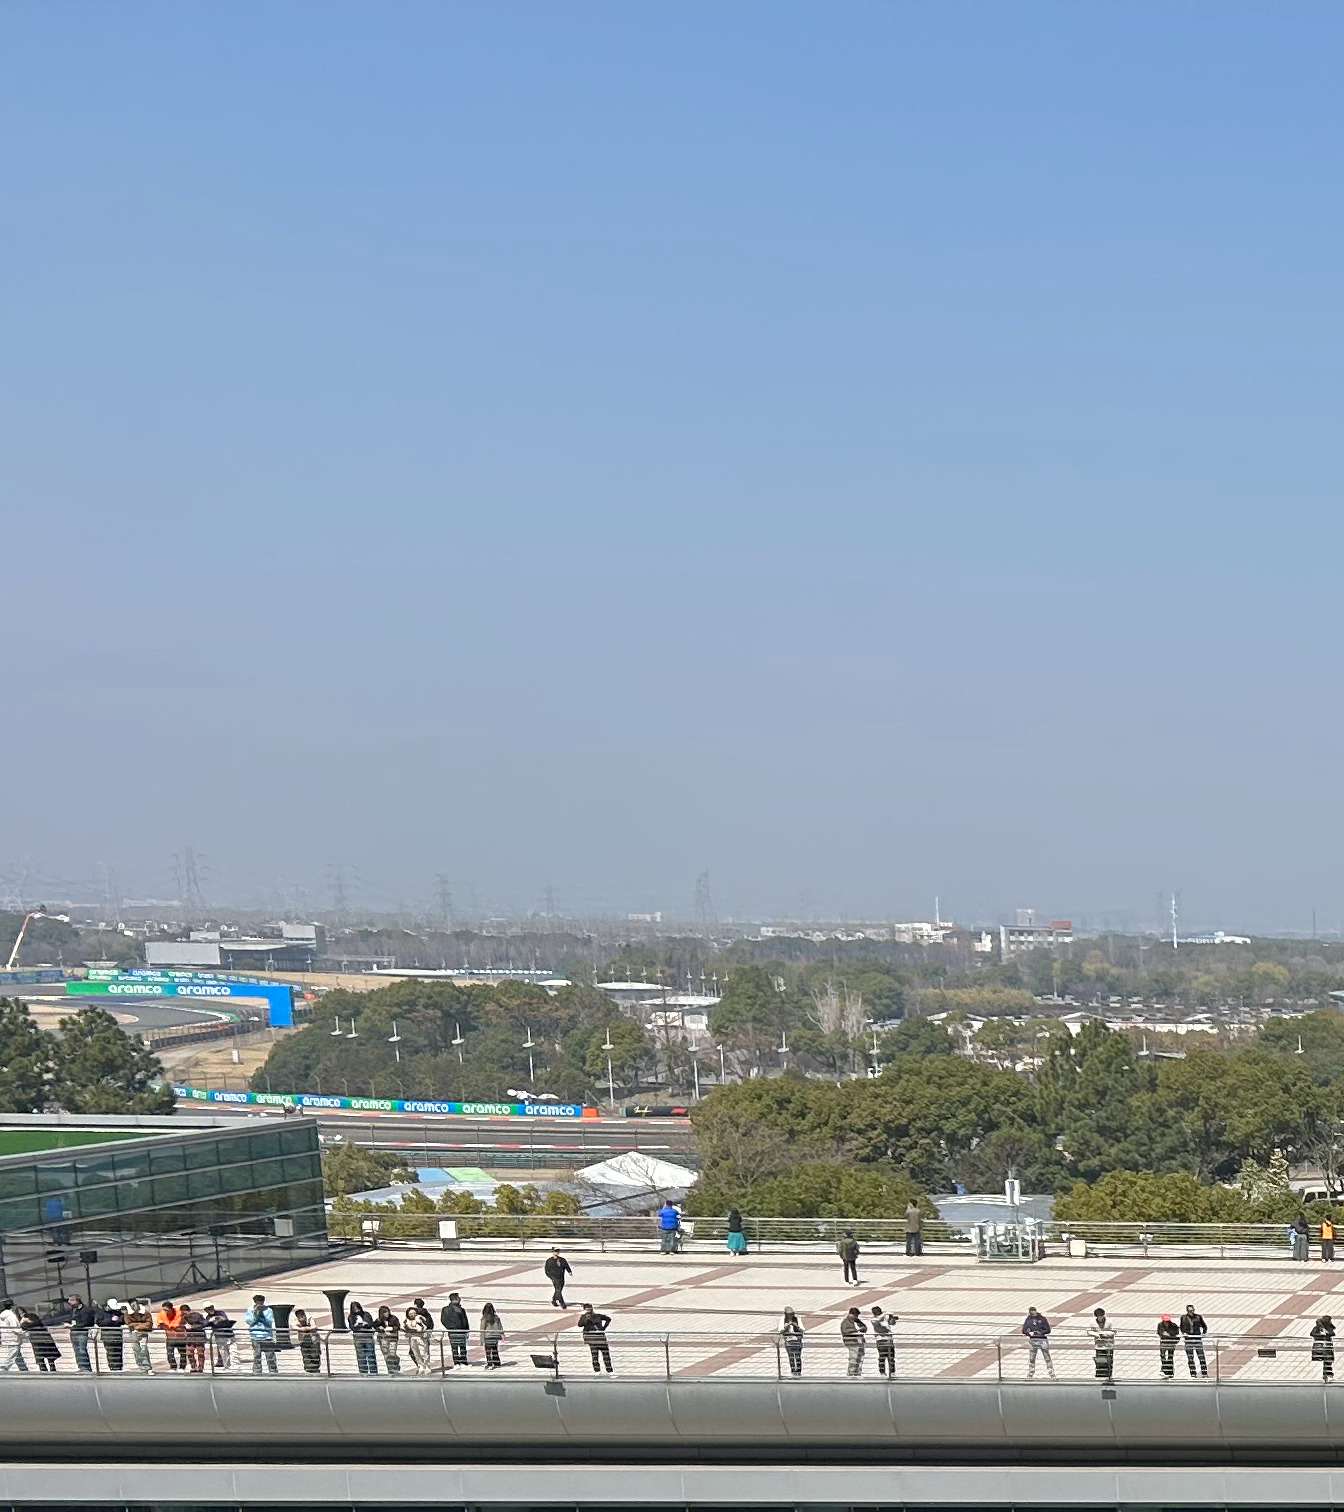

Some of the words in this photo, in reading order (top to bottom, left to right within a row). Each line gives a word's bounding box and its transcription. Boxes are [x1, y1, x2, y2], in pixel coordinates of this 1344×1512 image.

[108, 984, 162, 994] aramco
[176, 984, 230, 996] aramco
[302, 1096, 340, 1108] aramco
[352, 1099, 392, 1110] aramco
[404, 1102, 449, 1113] aramco
[462, 1104, 511, 1115] aramco
[526, 1104, 575, 1116] aramco
